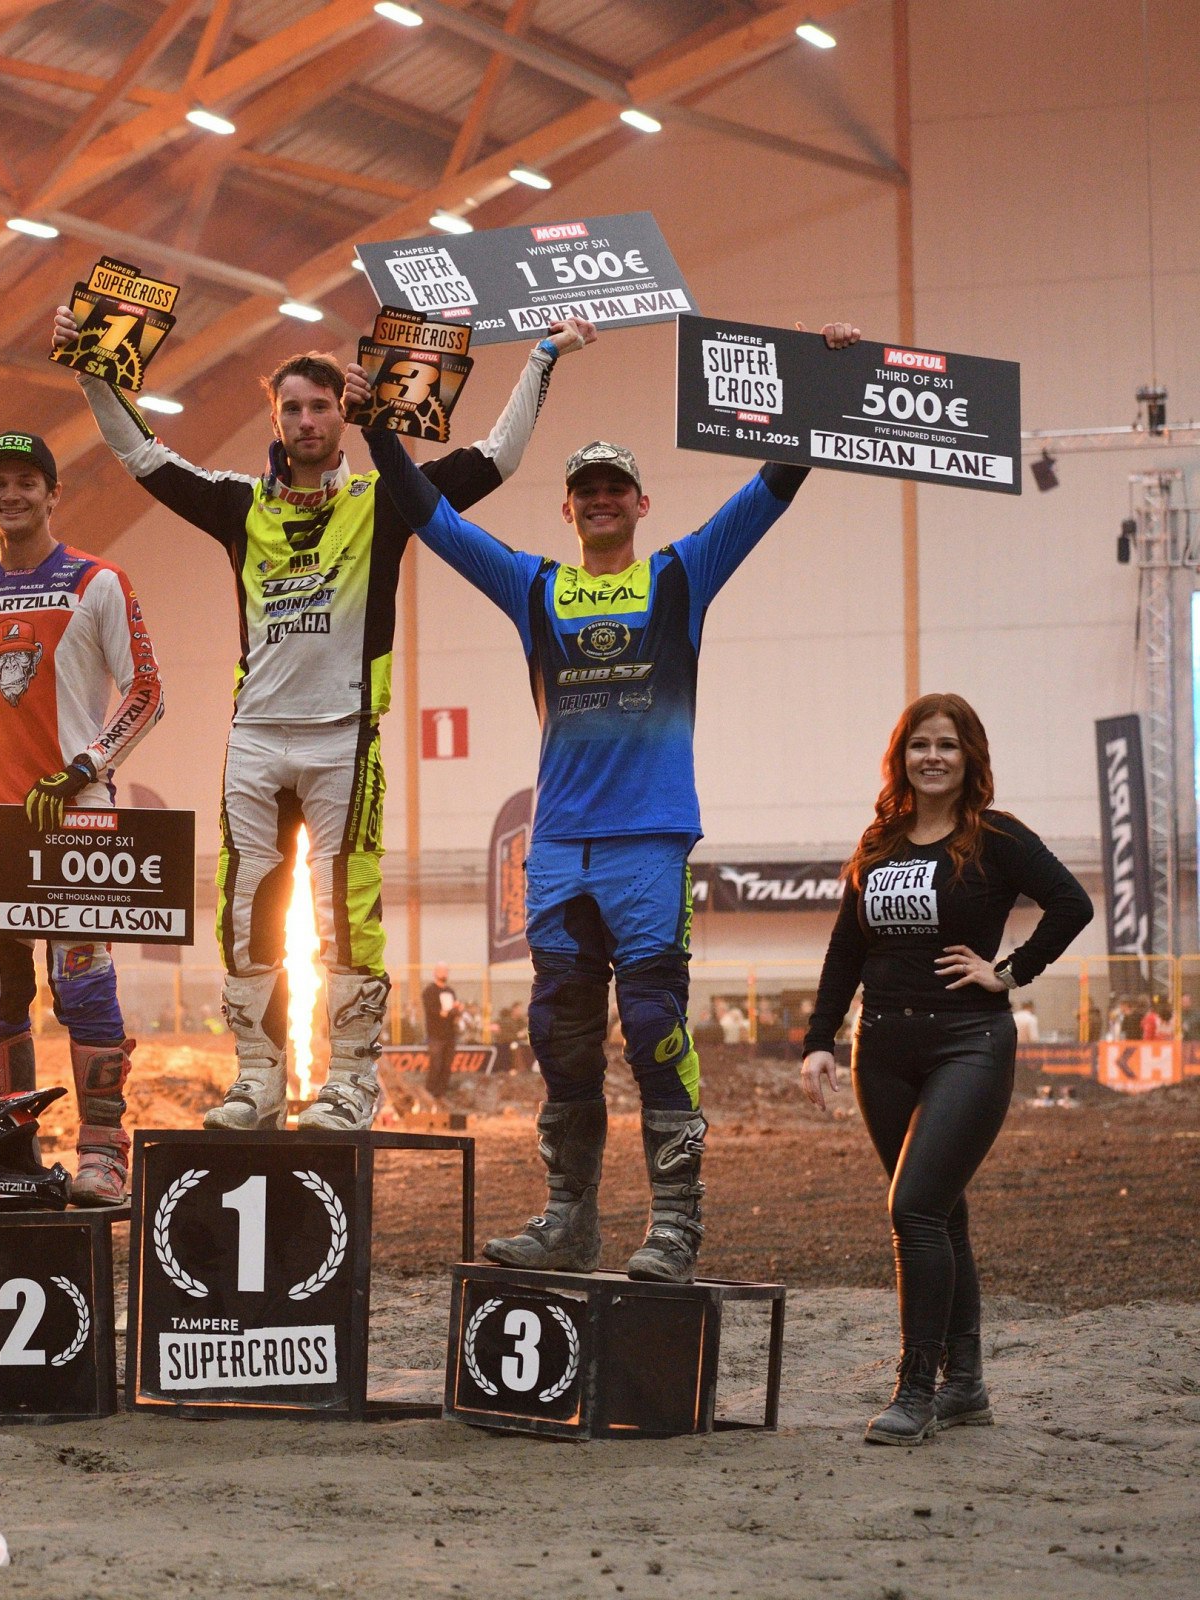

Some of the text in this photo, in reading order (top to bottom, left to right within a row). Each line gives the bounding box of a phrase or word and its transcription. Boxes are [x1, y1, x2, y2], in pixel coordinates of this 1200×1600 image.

[536, 224, 587, 241] MOTUL
[393, 246, 435, 257] TAMPERE
[526, 238, 610, 257] WINNER OF SX1
[104, 260, 135, 277] TAMPERE
[515, 249, 649, 287] 1 500€
[94, 271, 171, 307] SUPERCROSS
[410, 281, 471, 306] CROSS
[531, 281, 658, 303] ONE THOUSAND FIVE HUNDRED EUROS
[120, 304, 145, 316] MOTUL
[443, 308, 471, 318] MOTUL
[589, 291, 686, 321] MALAVAL
[386, 310, 422, 322] TAMPERE
[97, 314, 139, 352] 1
[379, 322, 464, 350] SUPERCROSS
[716, 332, 762, 345] TAMPERE
[90, 345, 120, 360] WINNER
[410, 352, 438, 361] MOTUL
[887, 351, 943, 370] MOTUL
[84, 360, 108, 377] SX
[378, 360, 440, 405] 3
[875, 369, 954, 389] THIRD OF SX1
[715, 376, 777, 408] CROSS
[389, 398, 417, 412] THIRD
[862, 384, 968, 427] 500€
[386, 416, 411, 432] SX
[738, 411, 769, 423] MOTUL
[697, 422, 799, 447] DATE: 8.11.2025
[874, 426, 957, 444] FIVE HUNDRED EUROS
[814, 433, 997, 478] TRISTAN LANE
[587, 621, 620, 631] PRIVATEER
[100, 689, 152, 749] PARTZILLA
[63, 814, 115, 828] MOTUL
[45, 834, 134, 847] SECOND OF SX1
[28, 850, 162, 884] 1 000€
[888, 859, 928, 867] TAMPERE
[65, 893, 105, 902] THOUSAND
[107, 894, 131, 903] EUROS
[746, 879, 846, 900] TALARI
[871, 895, 931, 921] CROSS
[7, 904, 172, 933] CADE CLASON
[1106, 1045, 1173, 1080] KH
[221, 1175, 267, 1292] 1
[171, 1317, 239, 1331] TAMPERE
[167, 1336, 327, 1380] SUPERCROSS
[501, 1309, 542, 1392] 3
